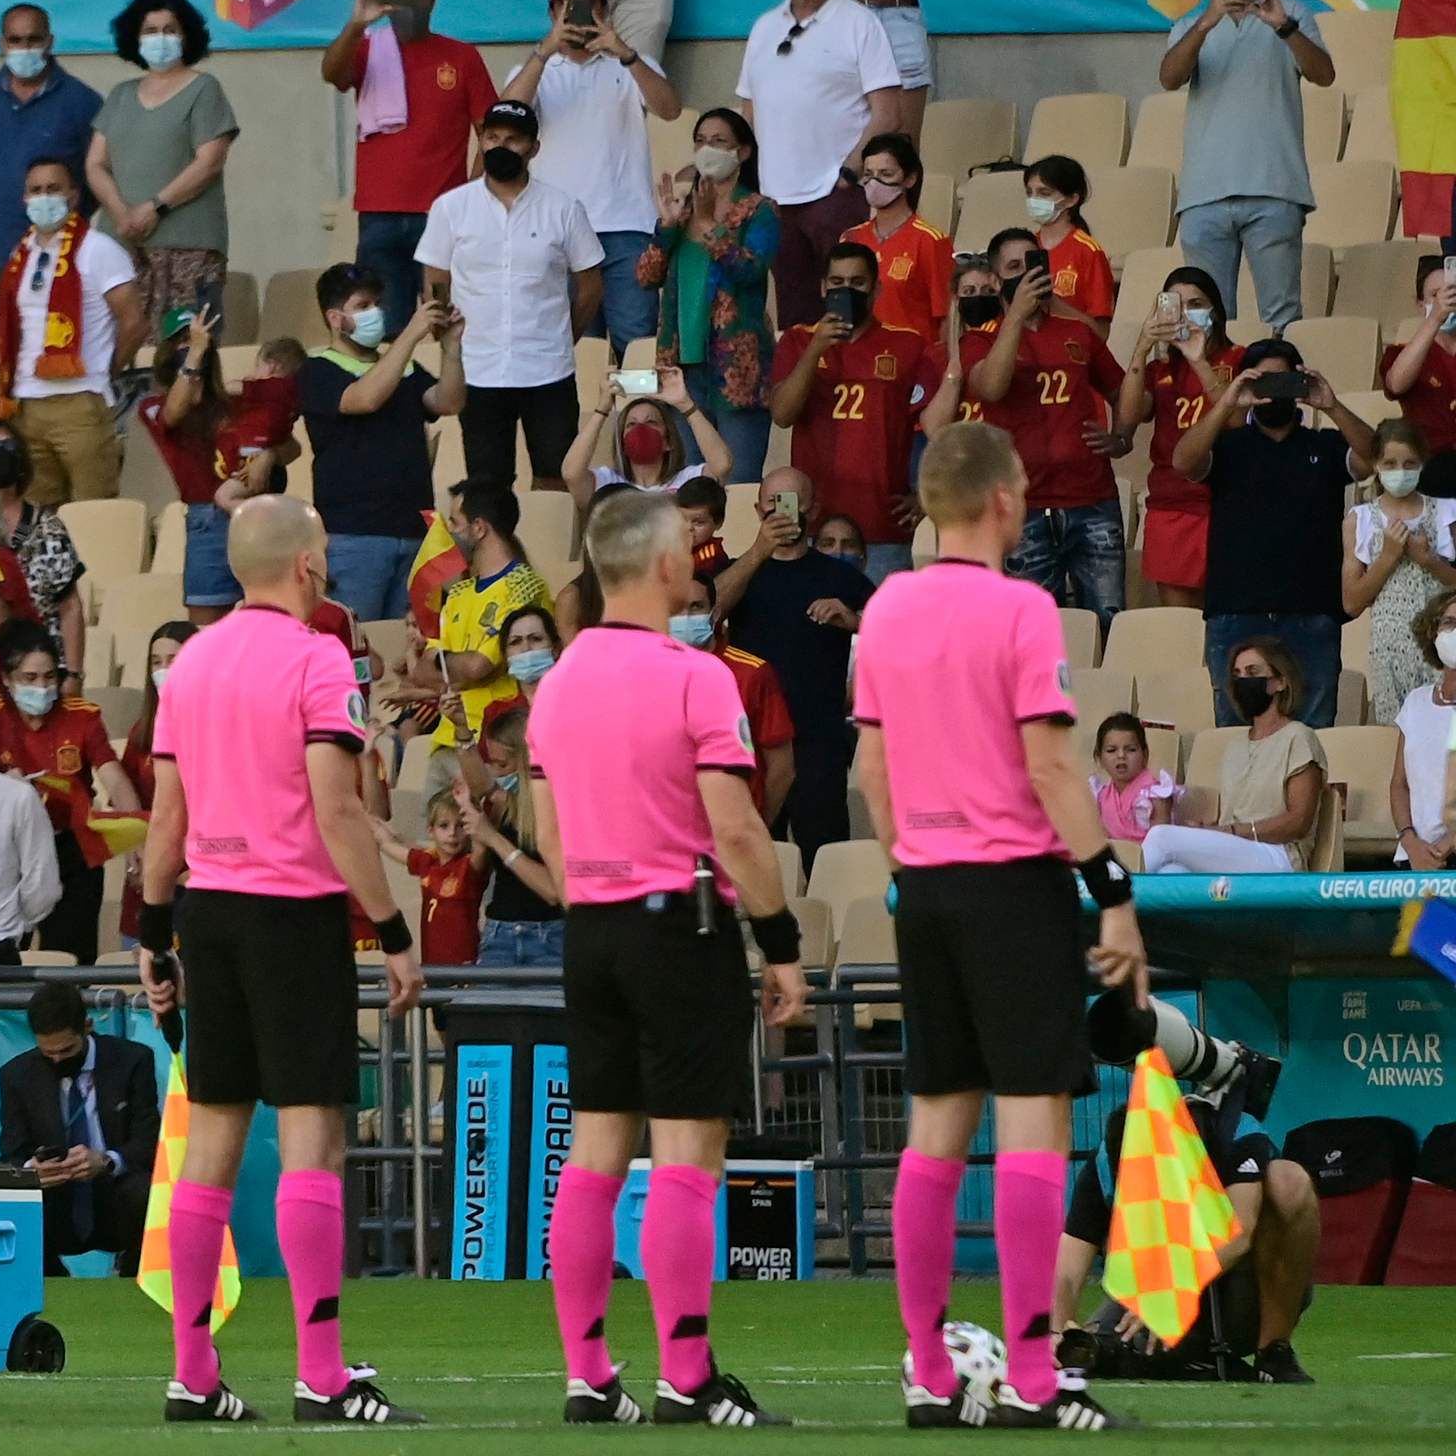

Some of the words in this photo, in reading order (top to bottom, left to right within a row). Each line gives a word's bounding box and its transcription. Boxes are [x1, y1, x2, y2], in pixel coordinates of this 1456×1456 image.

[831, 383, 866, 420] 22
[1036, 369, 1071, 406] 22
[1319, 878, 1366, 899] UEFA
[1368, 877, 1416, 898] EURO
[1343, 1032, 1442, 1070] QATAR
[1367, 1067, 1444, 1086] AIRWAYS
[729, 1246, 792, 1266] POWER
